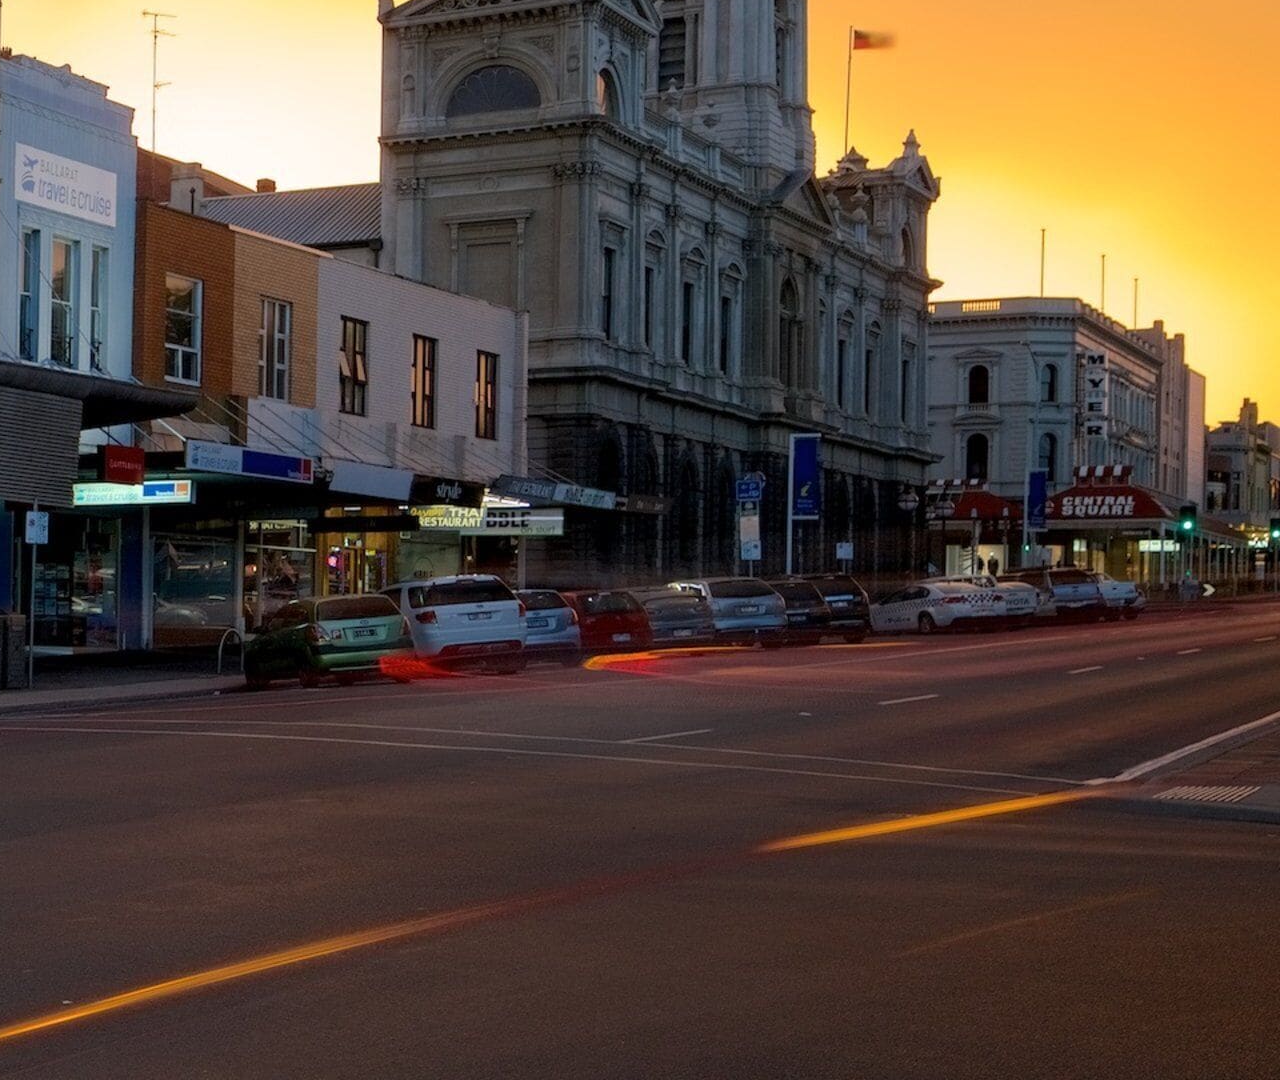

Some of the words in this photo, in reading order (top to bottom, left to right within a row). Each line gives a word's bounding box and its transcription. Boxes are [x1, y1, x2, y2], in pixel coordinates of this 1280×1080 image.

[40, 159, 79, 180] BALLARAT
[1087, 355, 1105, 436] MYER
[1061, 496, 1135, 506] CENTRAL
[449, 507, 484, 517] THAI
[1061, 505, 1134, 517] SQUARE
[418, 516, 483, 527] RESTAURANT
